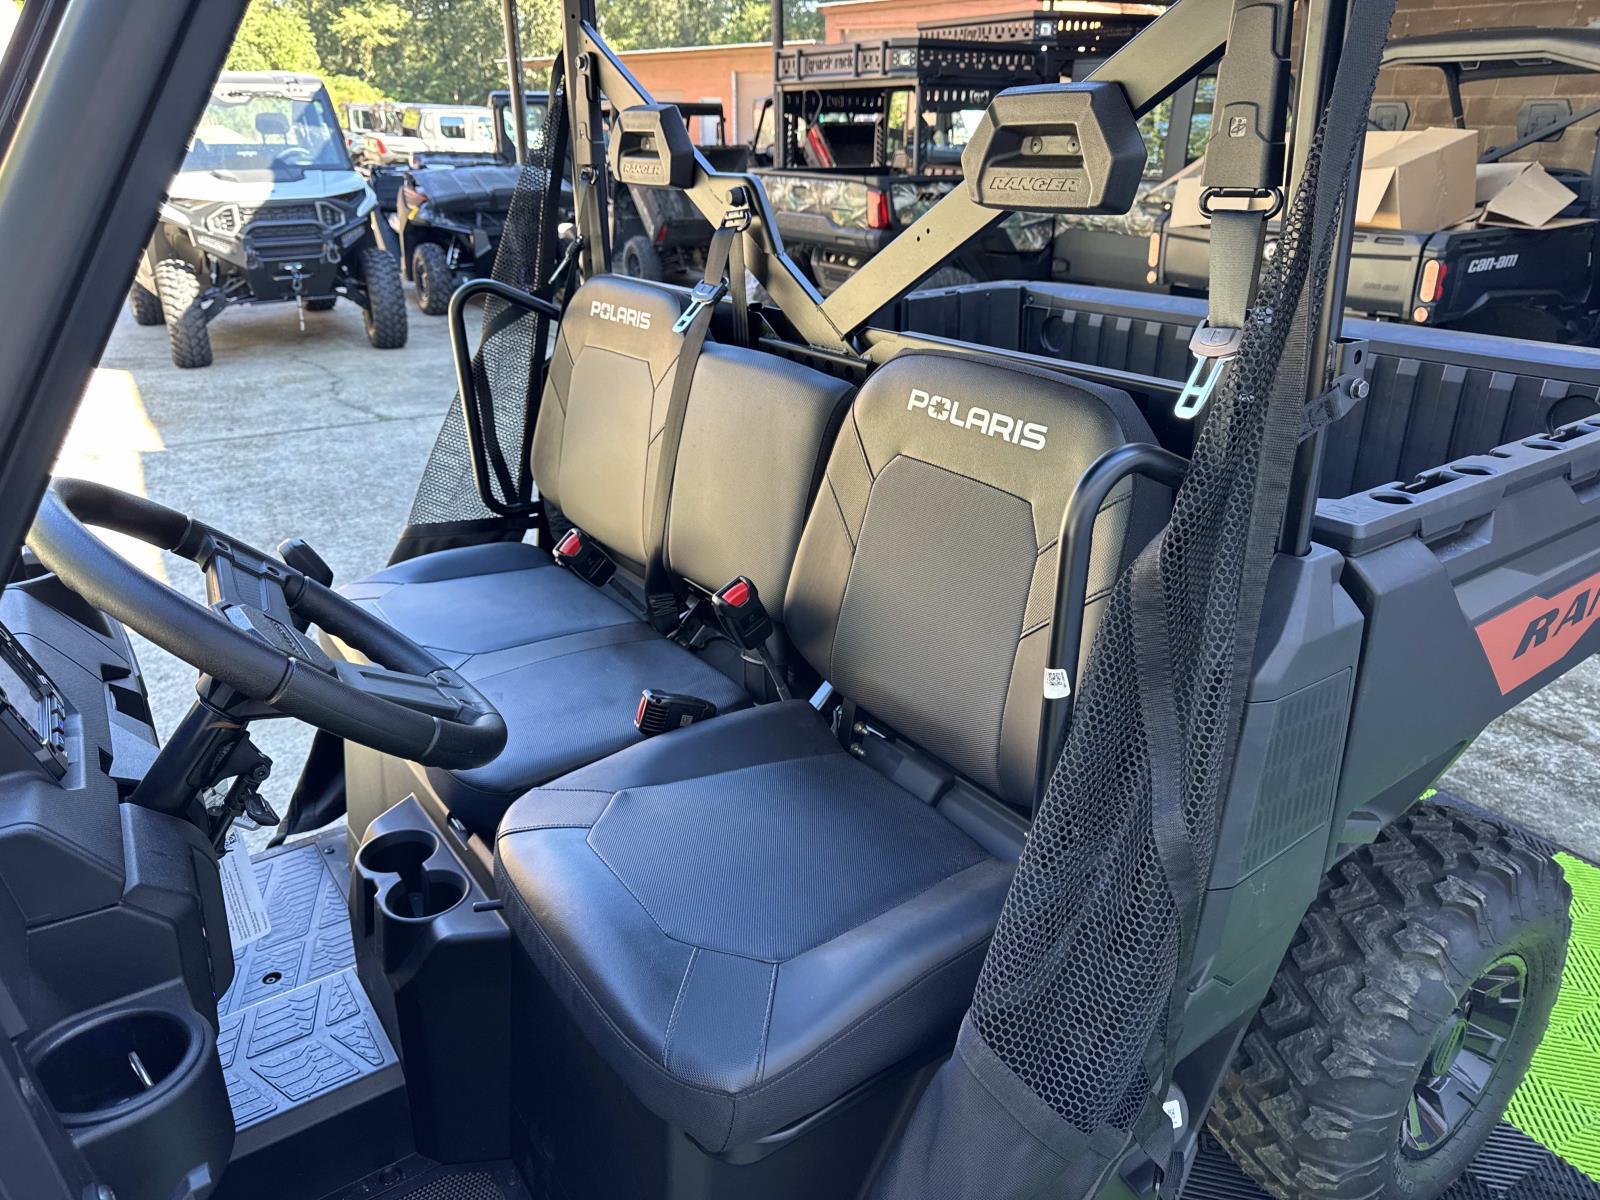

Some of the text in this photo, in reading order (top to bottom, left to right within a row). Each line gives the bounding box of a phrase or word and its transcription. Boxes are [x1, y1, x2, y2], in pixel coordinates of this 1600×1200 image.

[989, 176, 1080, 193] RANGER
[589, 300, 652, 330] POLARIS
[906, 388, 1049, 451] POLARIS
